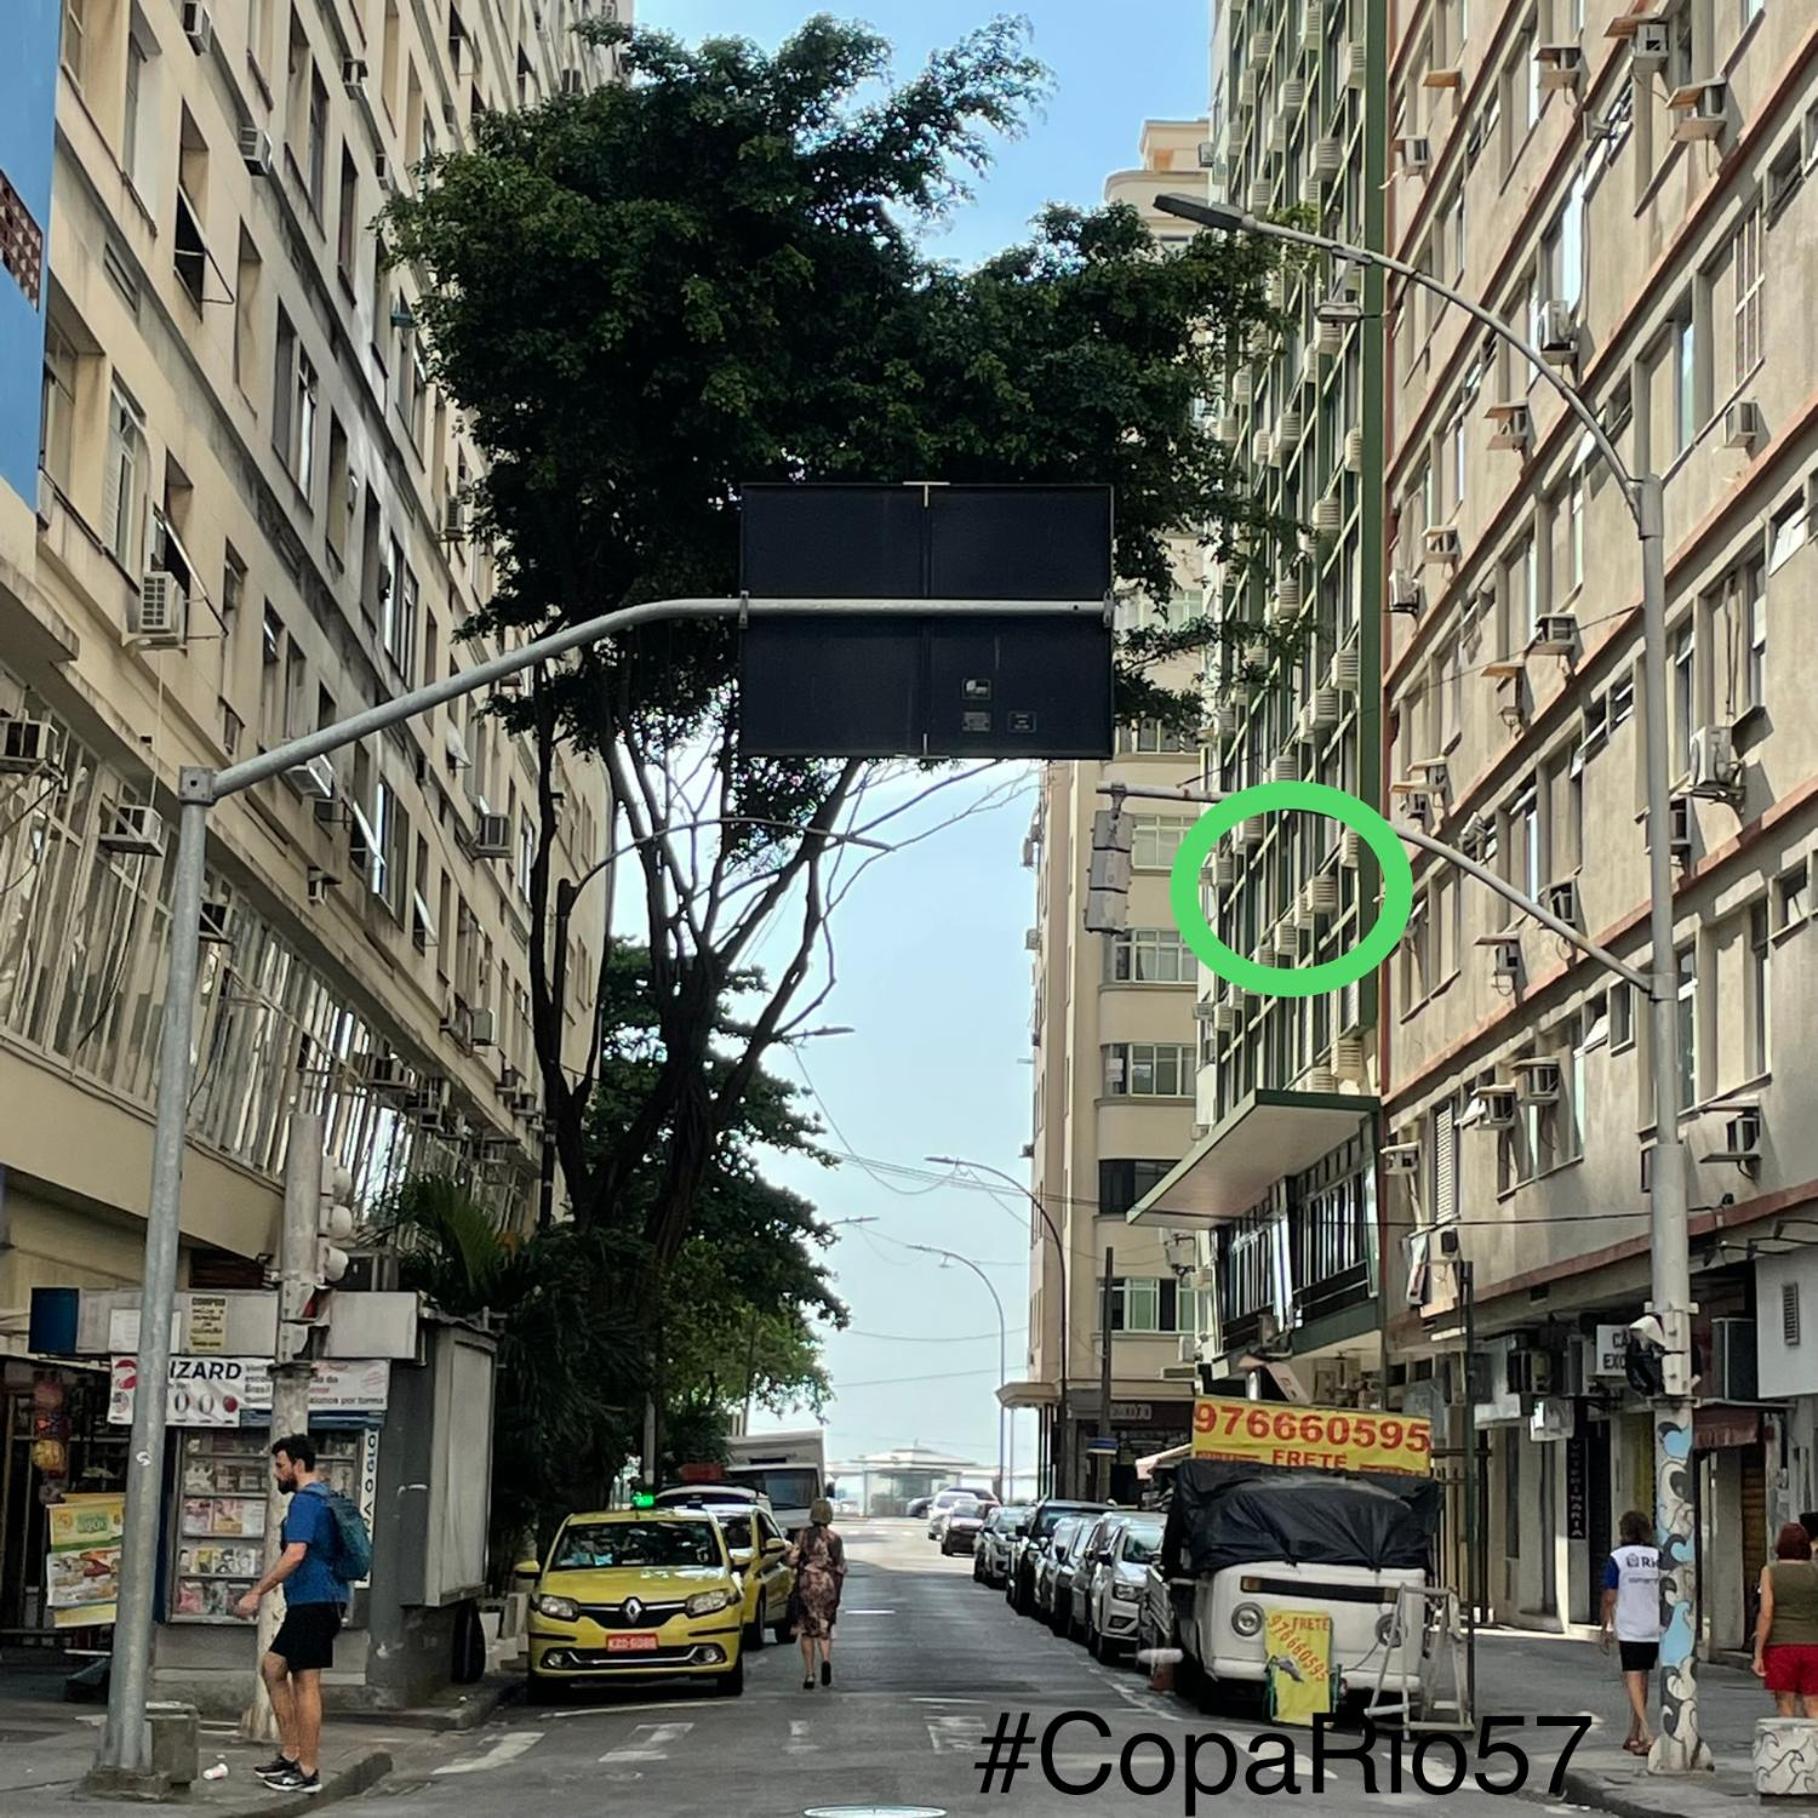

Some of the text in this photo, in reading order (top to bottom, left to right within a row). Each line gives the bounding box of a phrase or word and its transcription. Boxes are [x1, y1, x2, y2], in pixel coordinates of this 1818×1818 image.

[169, 1361, 242, 1380] IZARD
[1194, 1402, 1432, 1453] 976660595
[1271, 1449, 1349, 1473] FRETE
